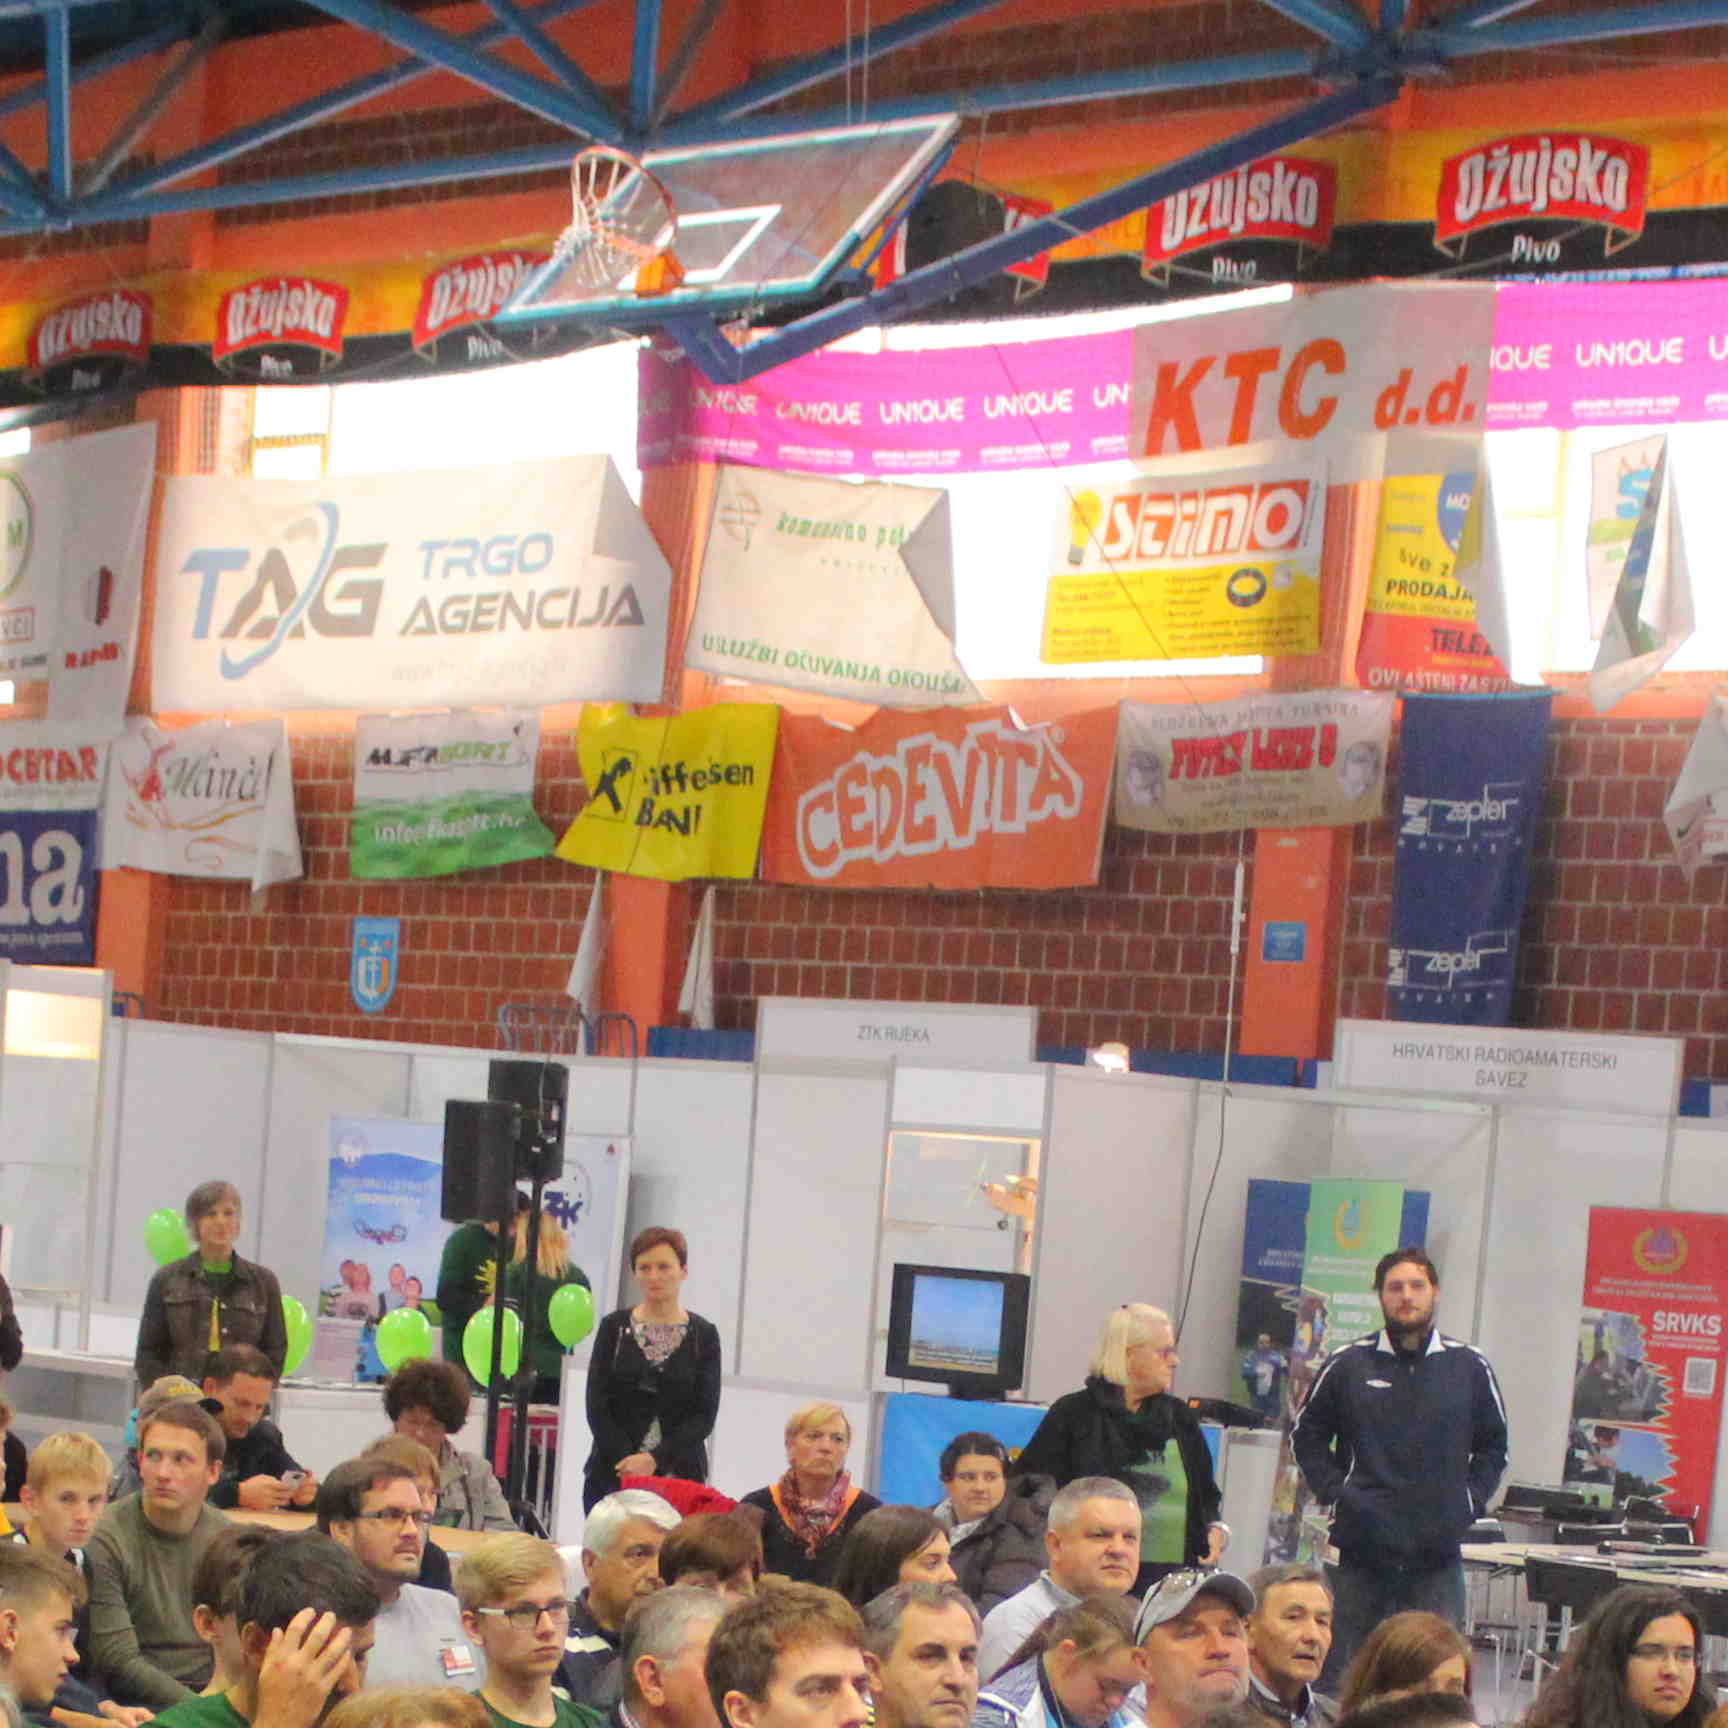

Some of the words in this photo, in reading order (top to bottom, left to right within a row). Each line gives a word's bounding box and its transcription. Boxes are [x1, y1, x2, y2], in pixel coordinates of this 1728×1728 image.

[1456, 138, 1630, 222] Ožujsko
[1511, 234, 1561, 265] Pivo
[226, 278, 338, 344] Ožujsko
[1145, 338, 1346, 459] KTC
[1373, 366, 1475, 431] d.d.
[417, 532, 554, 582] TRGO
[181, 540, 390, 641] TAG
[398, 583, 645, 638] AGENCIJA
[796, 719, 1084, 878] CEDEVITA
[857, 1024, 882, 1041] ZTK
[1392, 1042, 1471, 1065] HRVATSKI
[1474, 1045, 1618, 1071] RADIOAMATERSKI
[1475, 1069, 1529, 1090] SAVEZ
[1652, 1310, 1723, 1336] SRVKS
